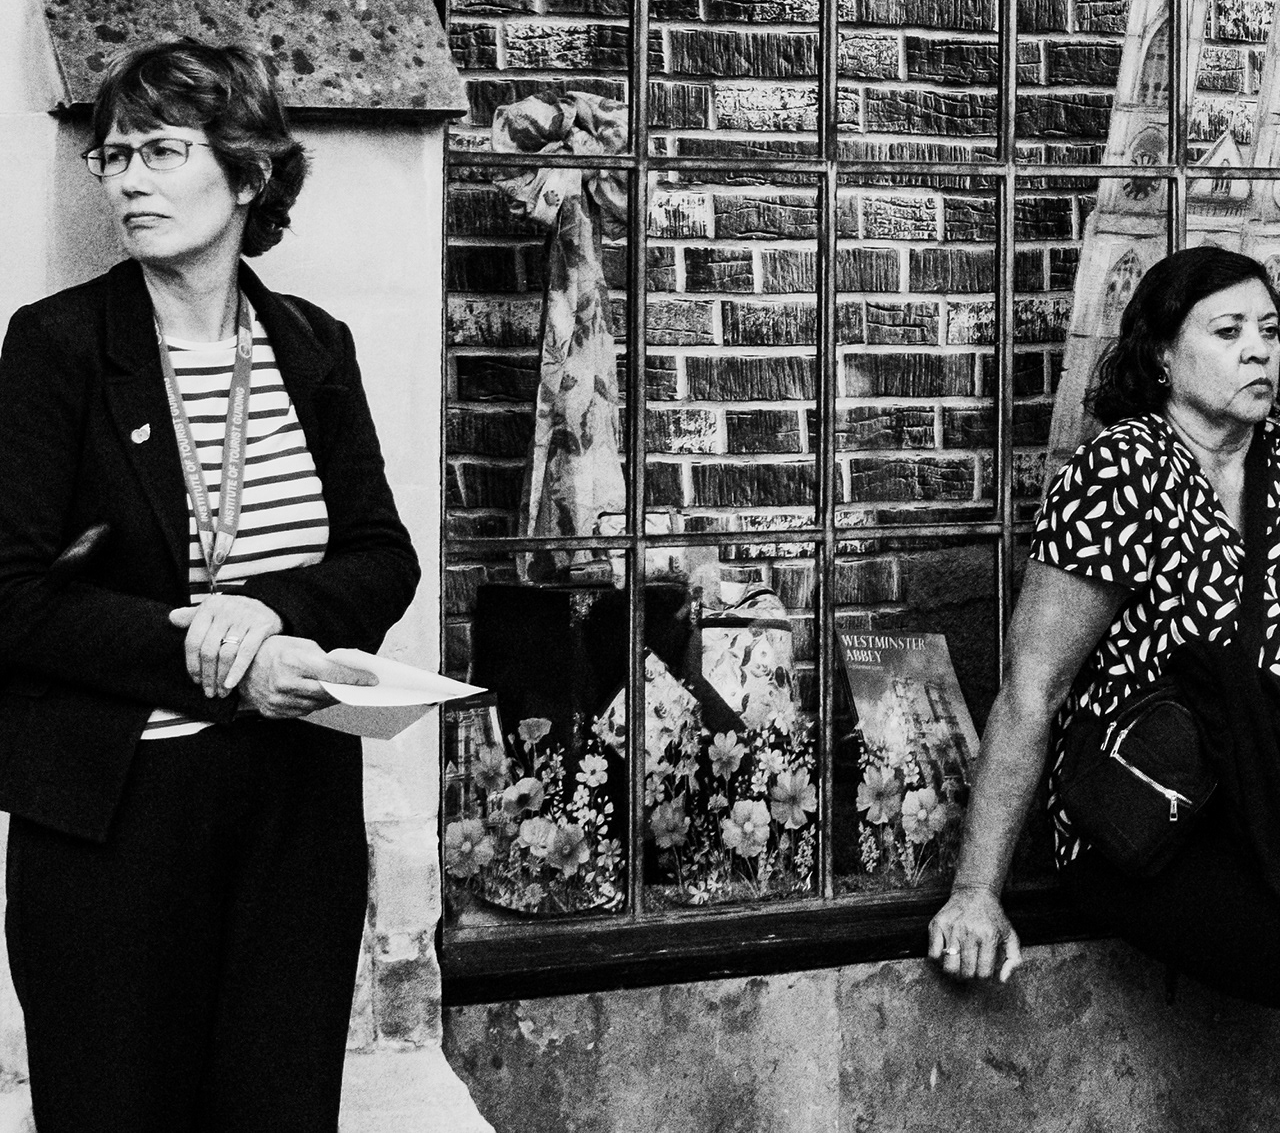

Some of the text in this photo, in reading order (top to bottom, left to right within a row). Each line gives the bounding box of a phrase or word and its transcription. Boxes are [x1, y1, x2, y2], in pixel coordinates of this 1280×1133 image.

[173, 417, 192, 459] TOURIST
[184, 457, 197, 472] OF
[224, 386, 246, 525] INSTITUTE OF TOURIST GUIDING
[190, 473, 209, 522] INSTITUTE
[841, 635, 926, 650] WESTMINSTER
[846, 649, 882, 663] ABBEY
